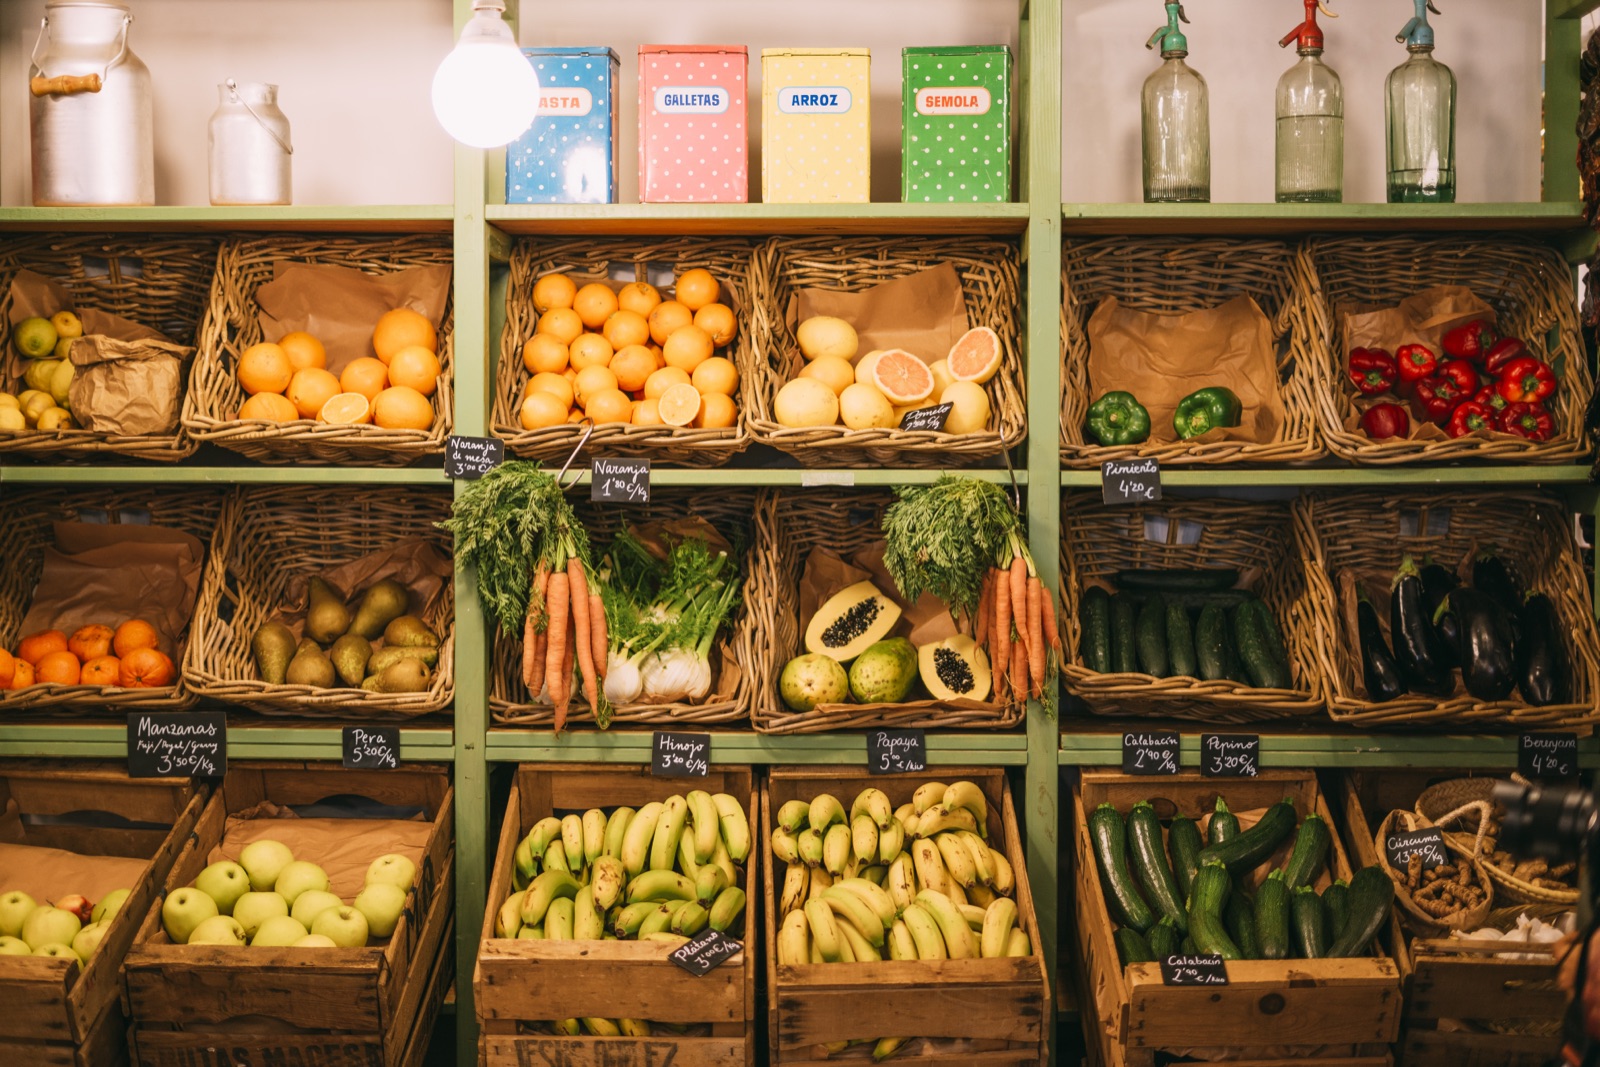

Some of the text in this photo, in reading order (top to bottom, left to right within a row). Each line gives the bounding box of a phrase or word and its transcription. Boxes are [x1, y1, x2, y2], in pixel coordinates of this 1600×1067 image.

[538, 97, 580, 108] ASTA
[664, 94, 720, 106] GALLETAS
[791, 94, 838, 106] ARROZ
[925, 95, 979, 108] SEMOLA
[905, 405, 951, 421] Pomelo
[451, 437, 497, 457] Naranja
[452, 450, 494, 464] de mesa
[594, 460, 649, 484] Naranja
[1105, 460, 1157, 476] Pimiento
[137, 716, 218, 737] Manzanas
[352, 729, 386, 745] Pera
[876, 731, 919, 755] Papaya
[1124, 733, 1178, 746] Calabacín
[660, 734, 704, 759] Hinojo
[1206, 736, 1258, 757] Pepino
[674, 931, 718, 962] Plátano
